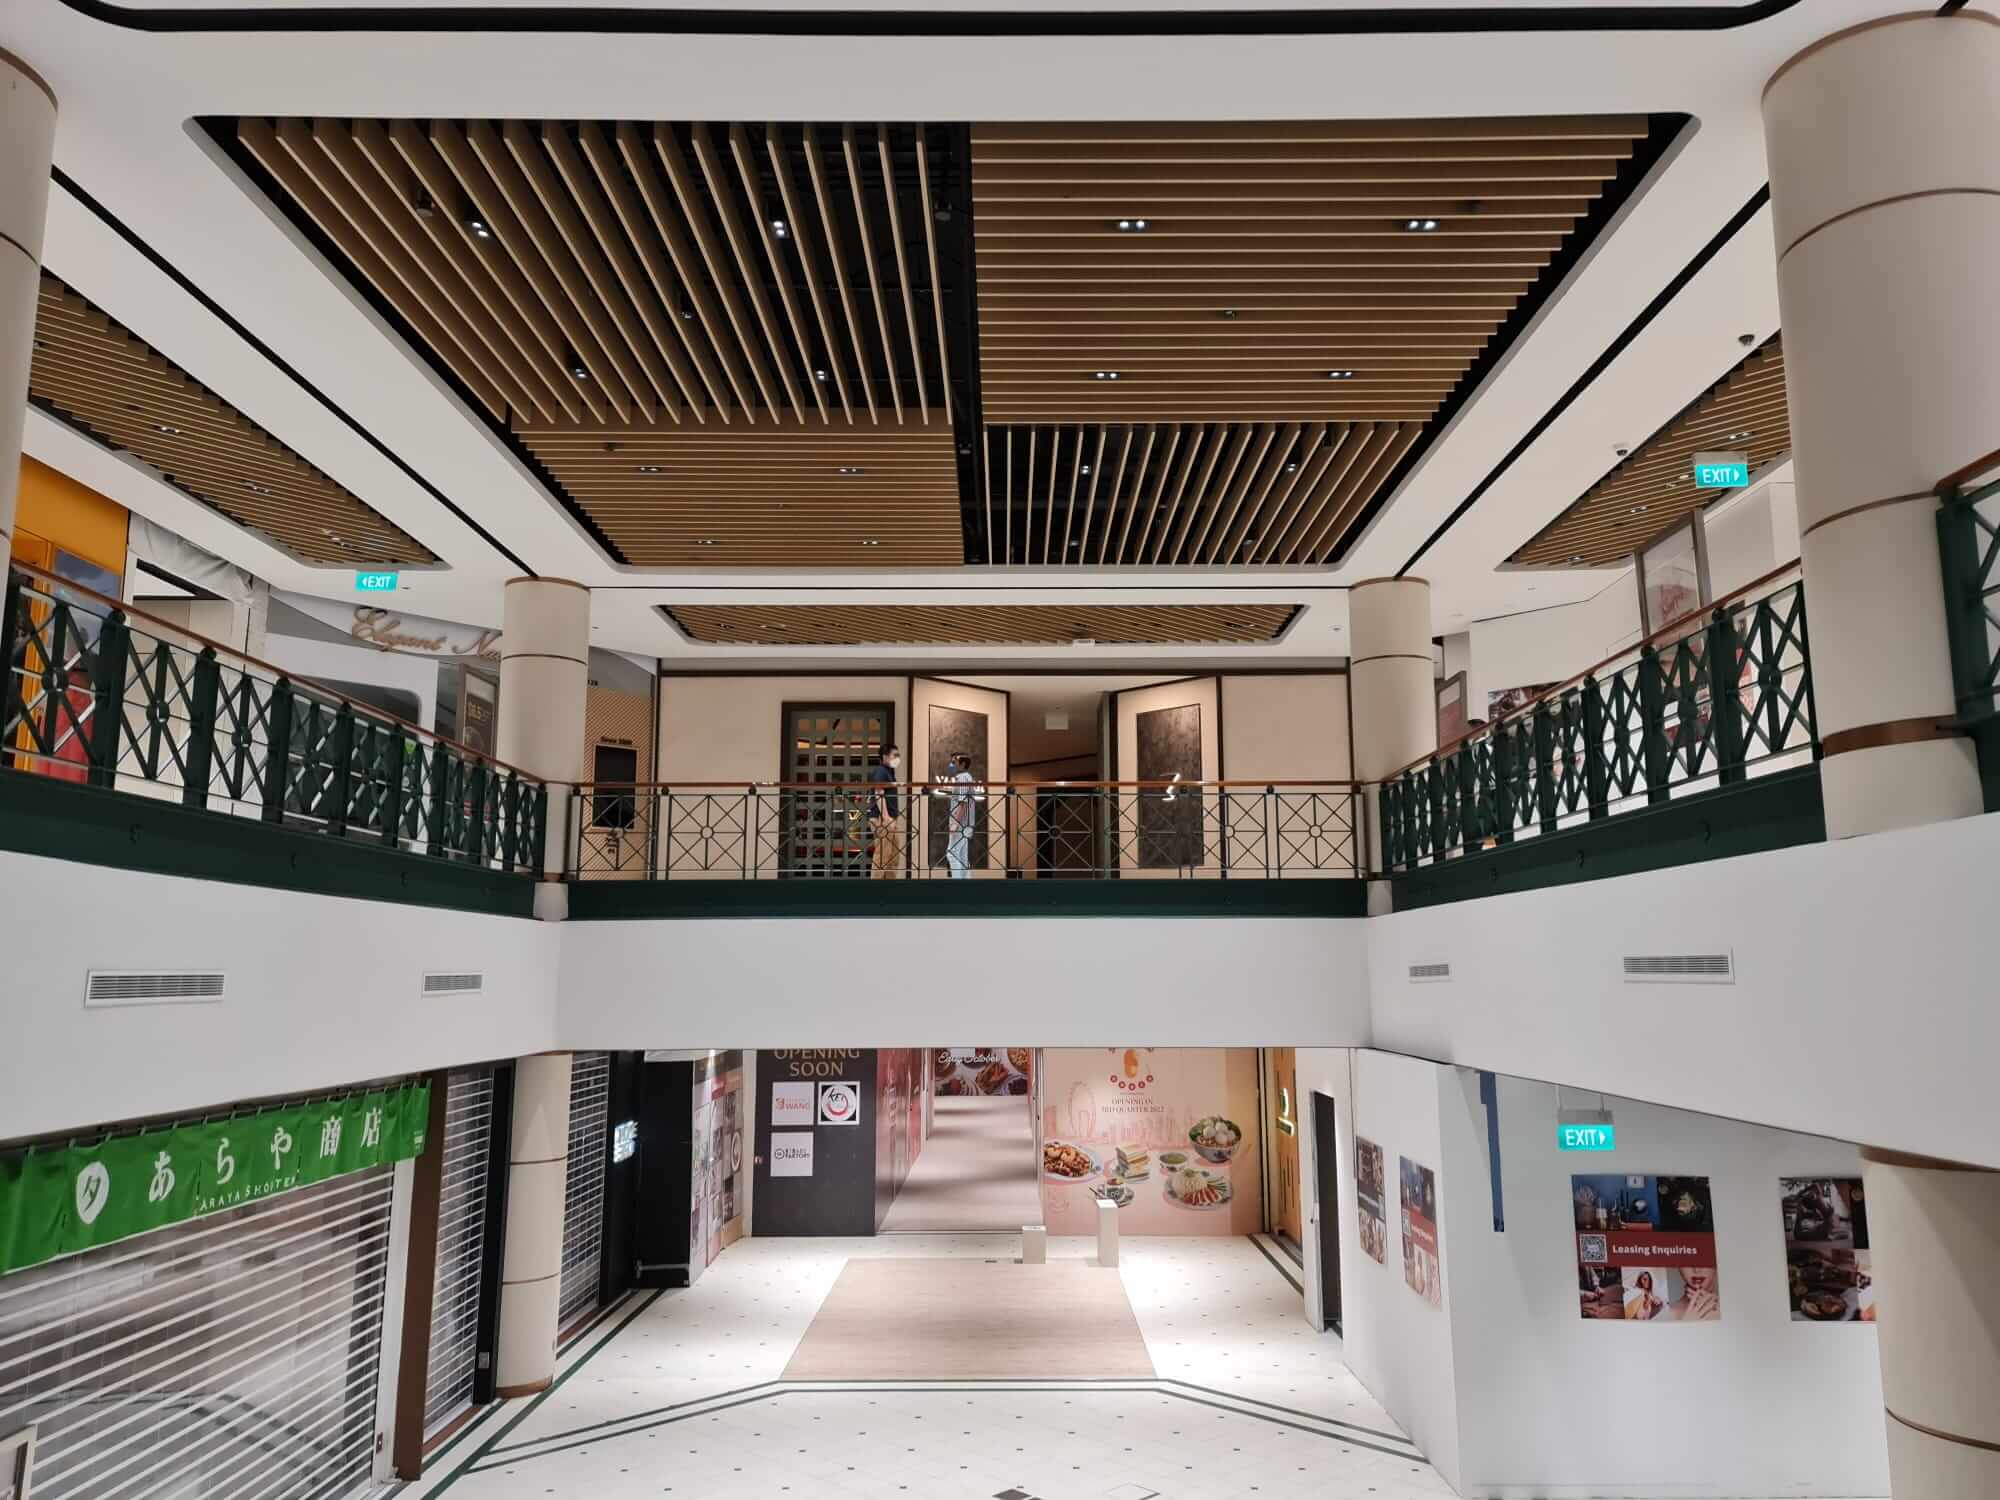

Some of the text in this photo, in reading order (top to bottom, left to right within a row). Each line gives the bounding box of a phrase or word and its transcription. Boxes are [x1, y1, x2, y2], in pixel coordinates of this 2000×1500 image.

[1702, 469, 1731, 484] EXIT
[367, 574, 391, 589] EXIT
[774, 1048, 860, 1060] OPENING
[789, 1061, 844, 1077] SOON
[1564, 1128, 1598, 1146] EXIT
[148, 1106, 383, 1203] あらや商店
[199, 1190, 240, 1212] ARAYA
[1612, 1243, 1697, 1257] Leasing Enquiries
